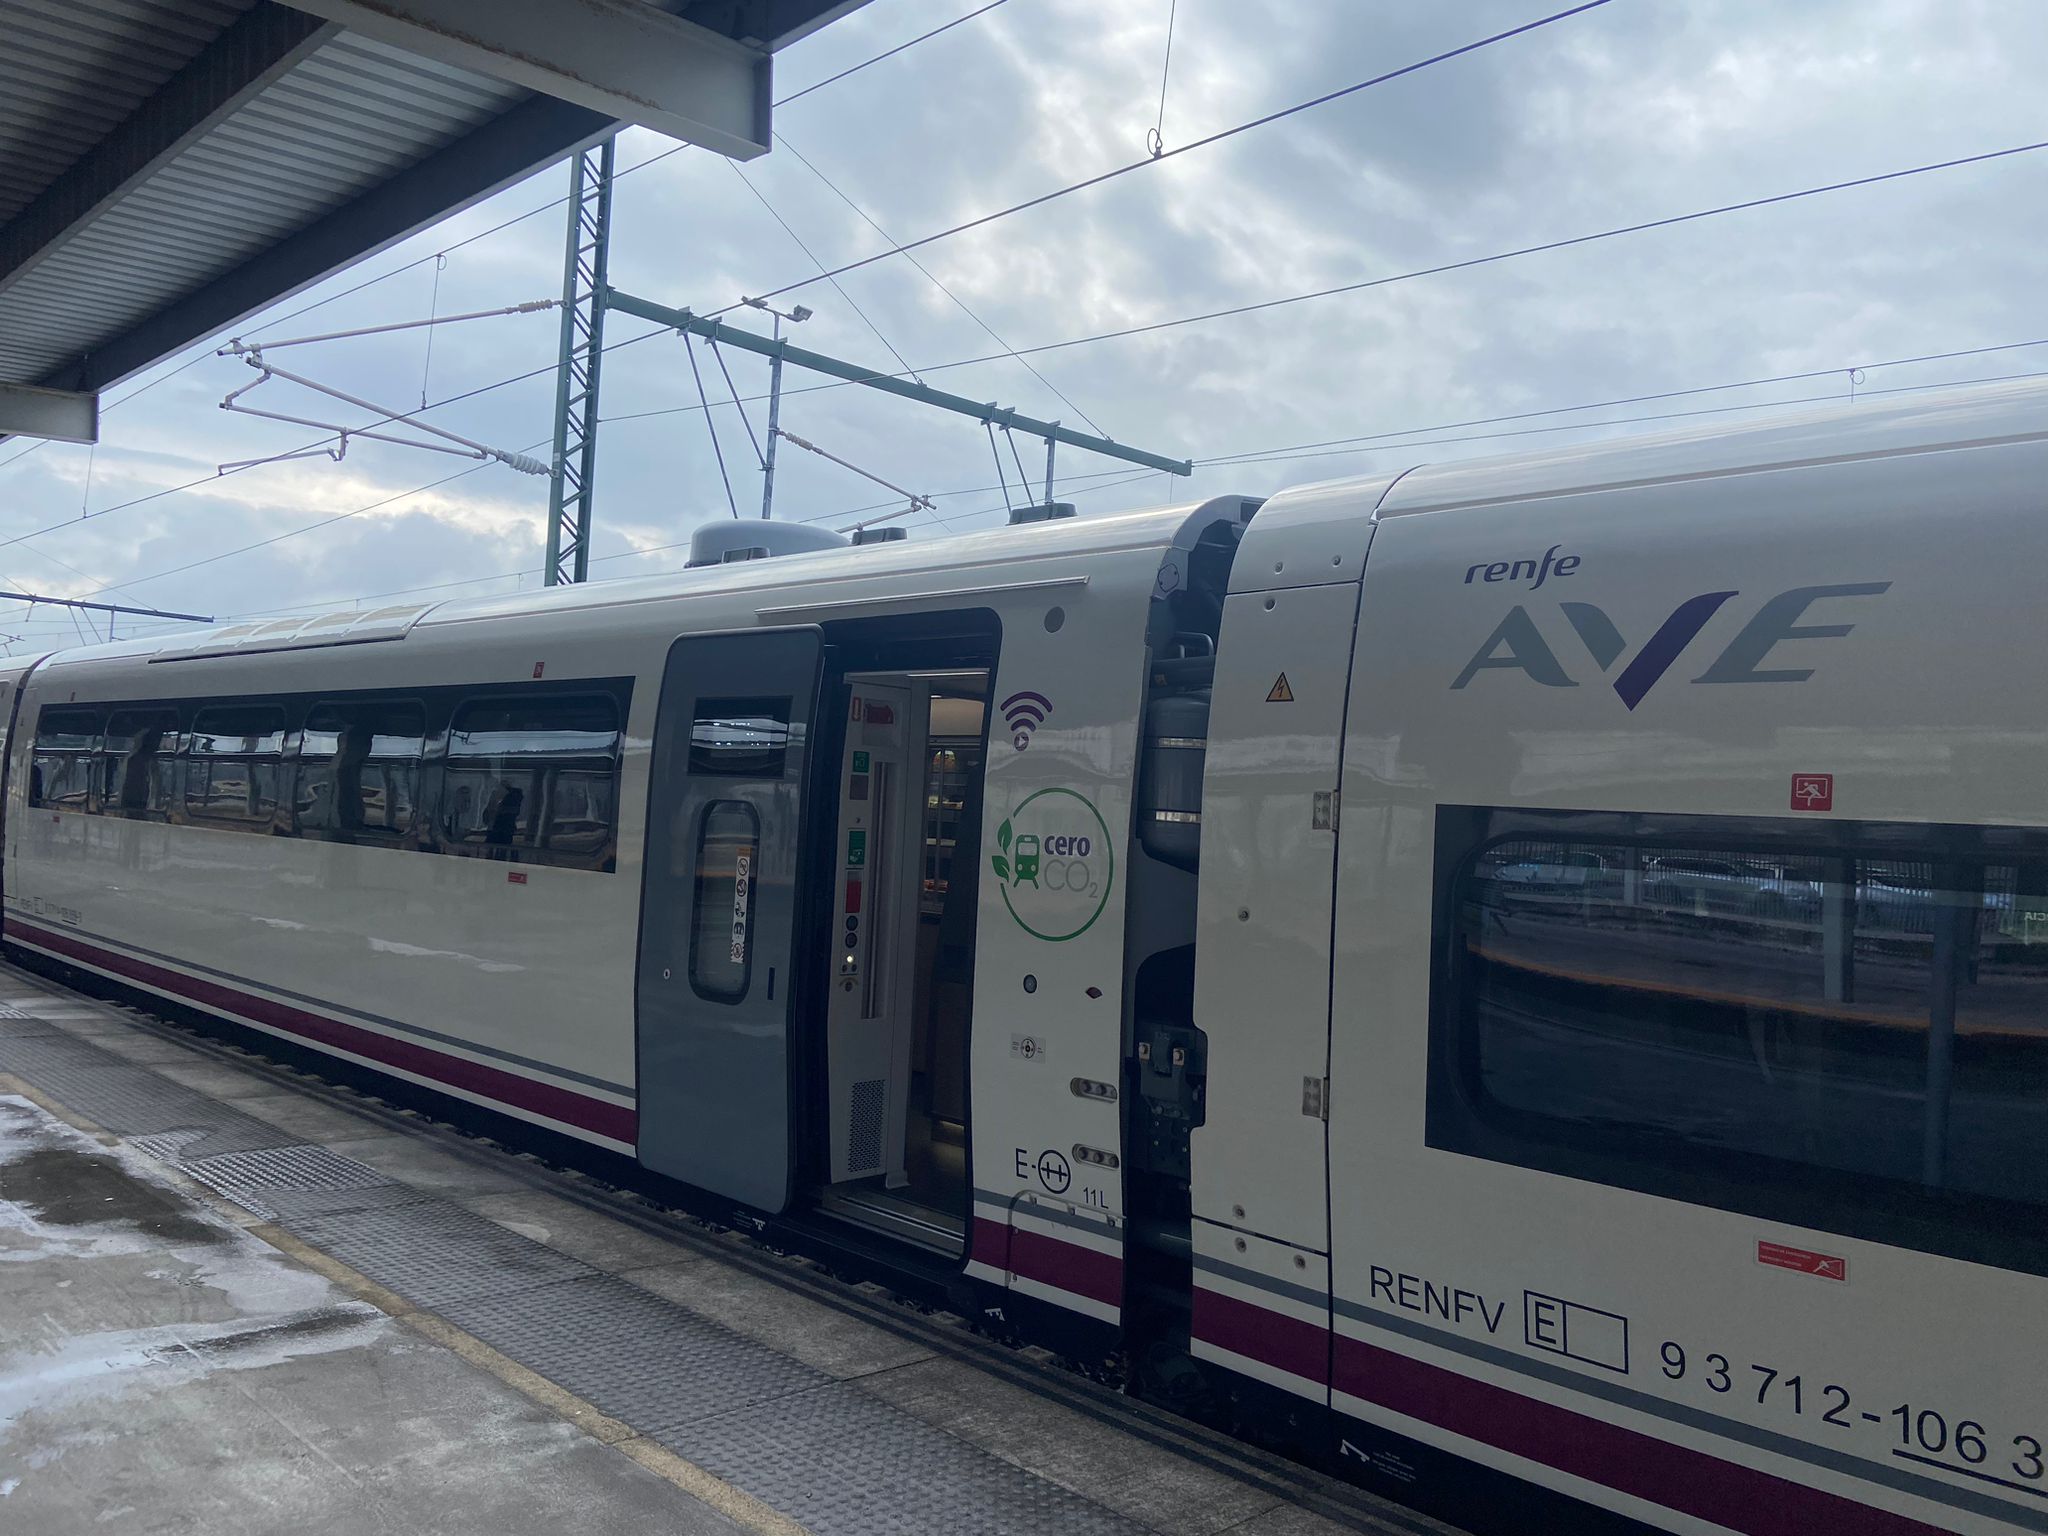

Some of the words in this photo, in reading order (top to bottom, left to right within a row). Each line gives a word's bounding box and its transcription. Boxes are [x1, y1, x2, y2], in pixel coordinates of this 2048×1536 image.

[1464, 544, 1581, 591] renfe
[1449, 581, 1894, 712] AVE
[1044, 835, 1091, 857] cero
[1370, 1264, 1505, 1334] RENFV
[1535, 1300, 1557, 1345] E
